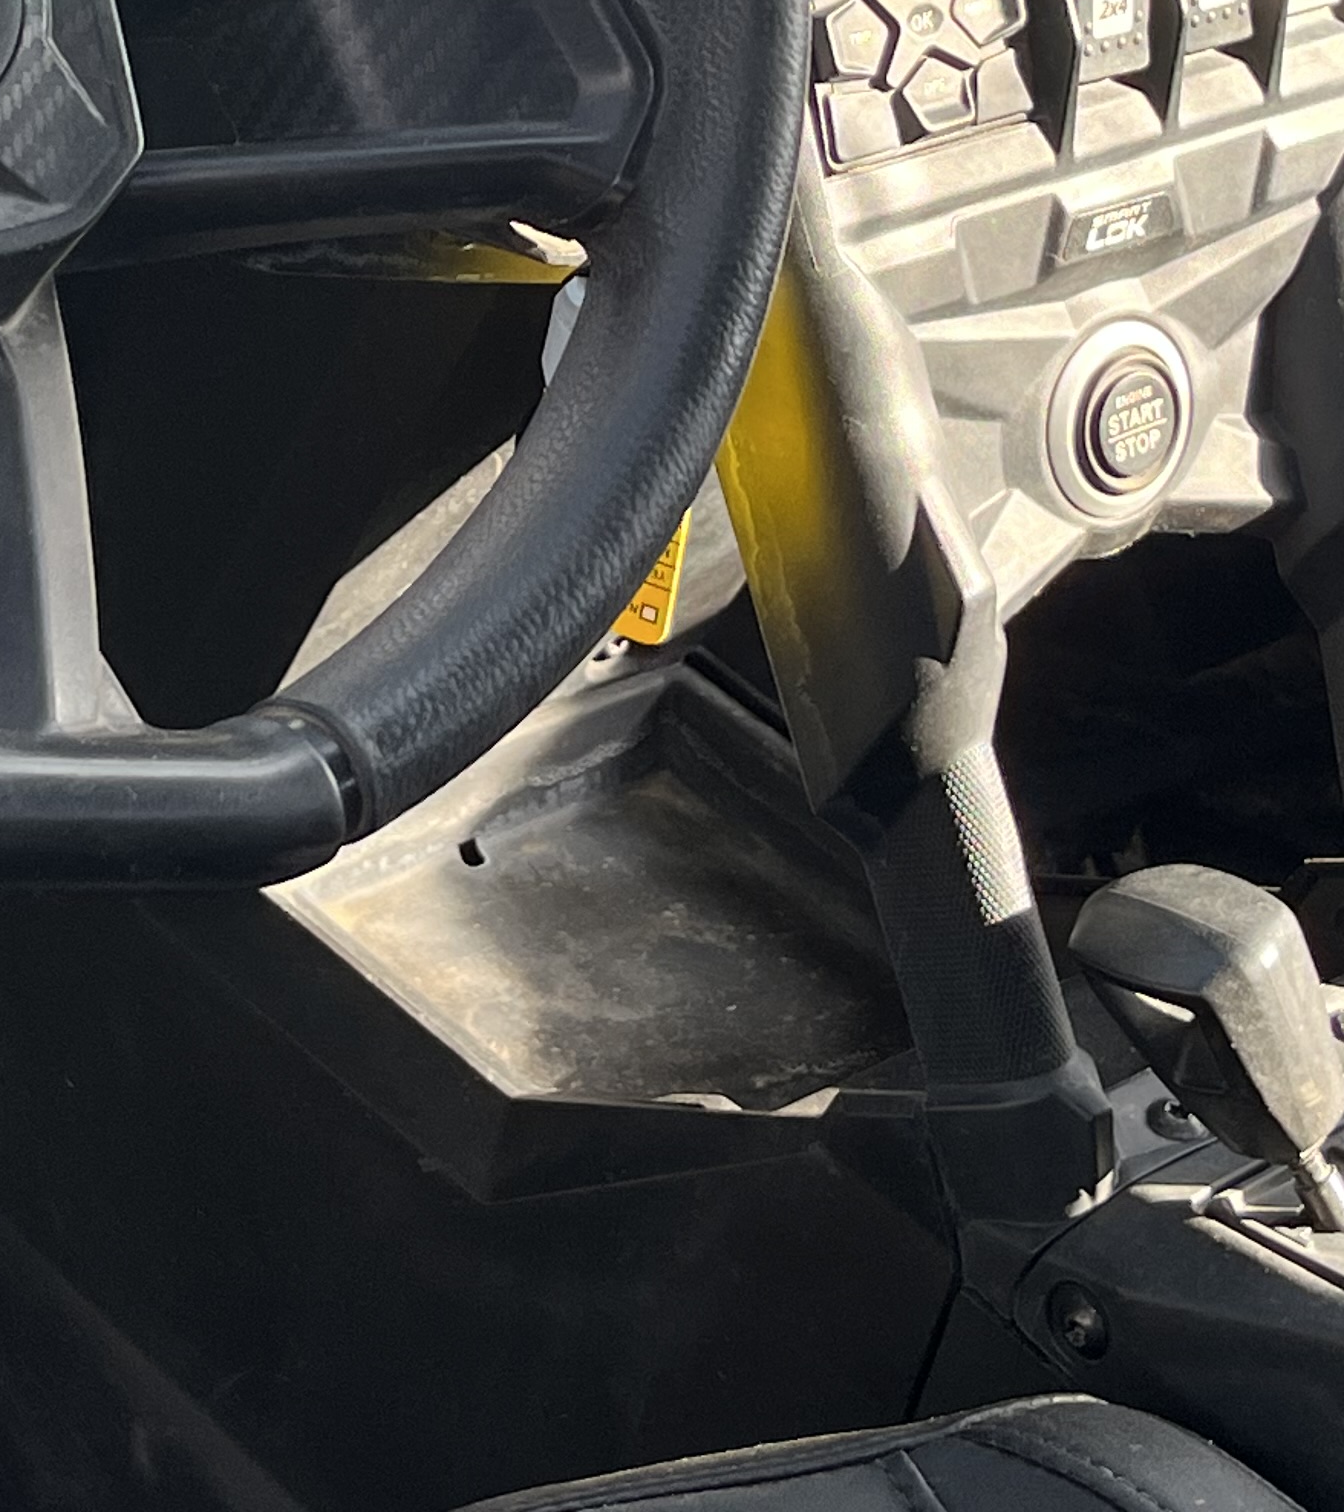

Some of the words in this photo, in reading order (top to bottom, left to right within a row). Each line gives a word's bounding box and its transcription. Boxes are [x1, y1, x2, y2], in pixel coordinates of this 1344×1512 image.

[909, 9, 936, 32] OK
[1085, 214, 1149, 251] LOK
[1108, 397, 1164, 436] START
[1115, 428, 1161, 463] STOP
